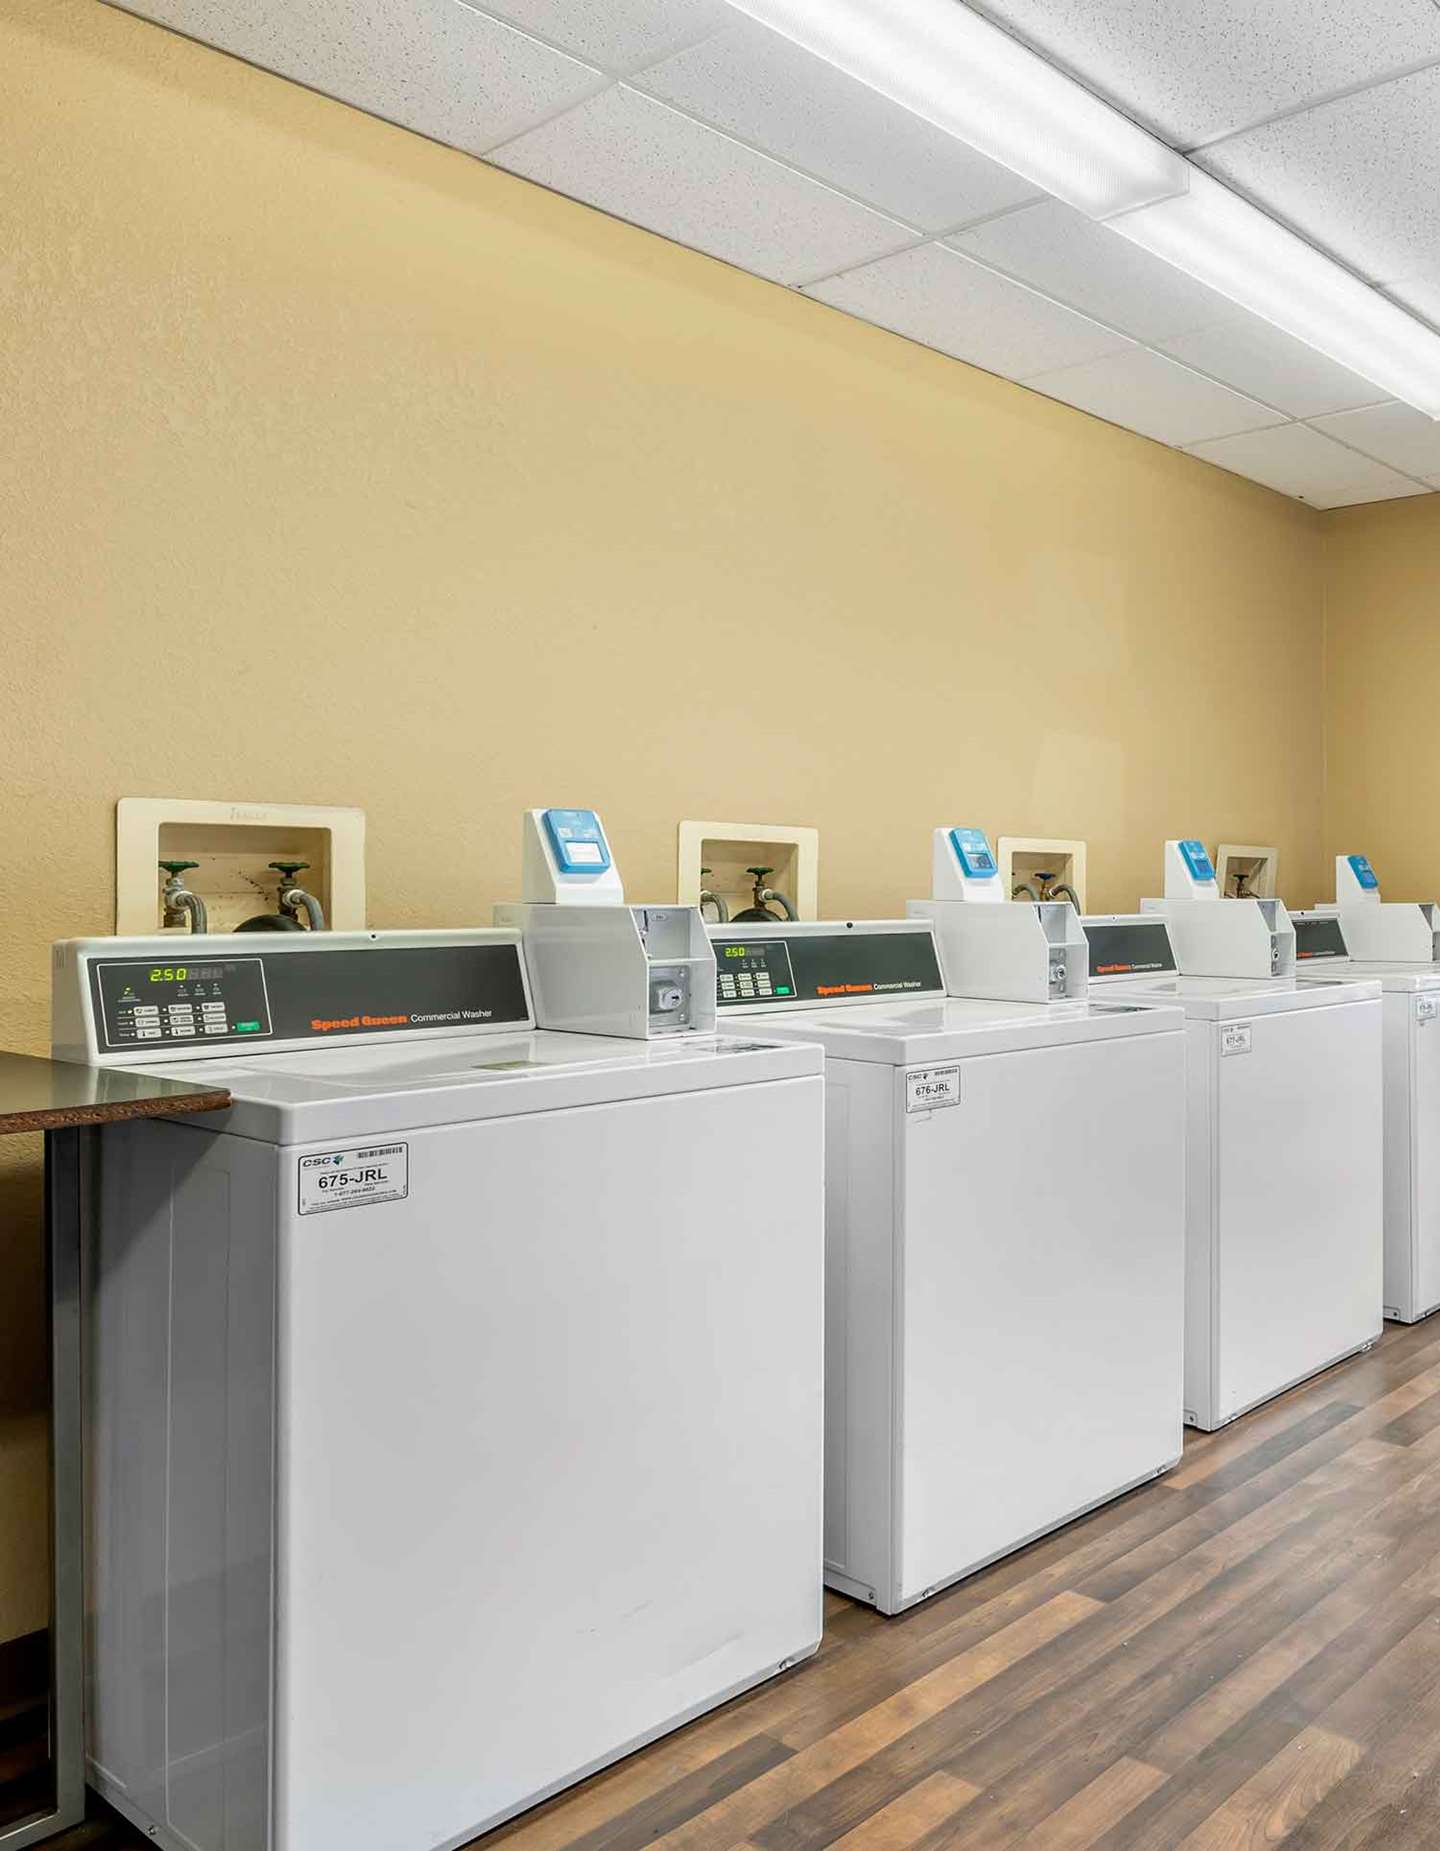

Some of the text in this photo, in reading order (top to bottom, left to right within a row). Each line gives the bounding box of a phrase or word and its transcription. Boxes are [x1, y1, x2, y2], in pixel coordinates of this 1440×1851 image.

[150, 968, 187, 982] 2.50
[312, 1010, 492, 1031] Speed Queen Commercial Washer
[915, 1083, 950, 1096] 676-JRL
[303, 1157, 331, 1167] CSC
[318, 1168, 388, 1189] 675-JRL
